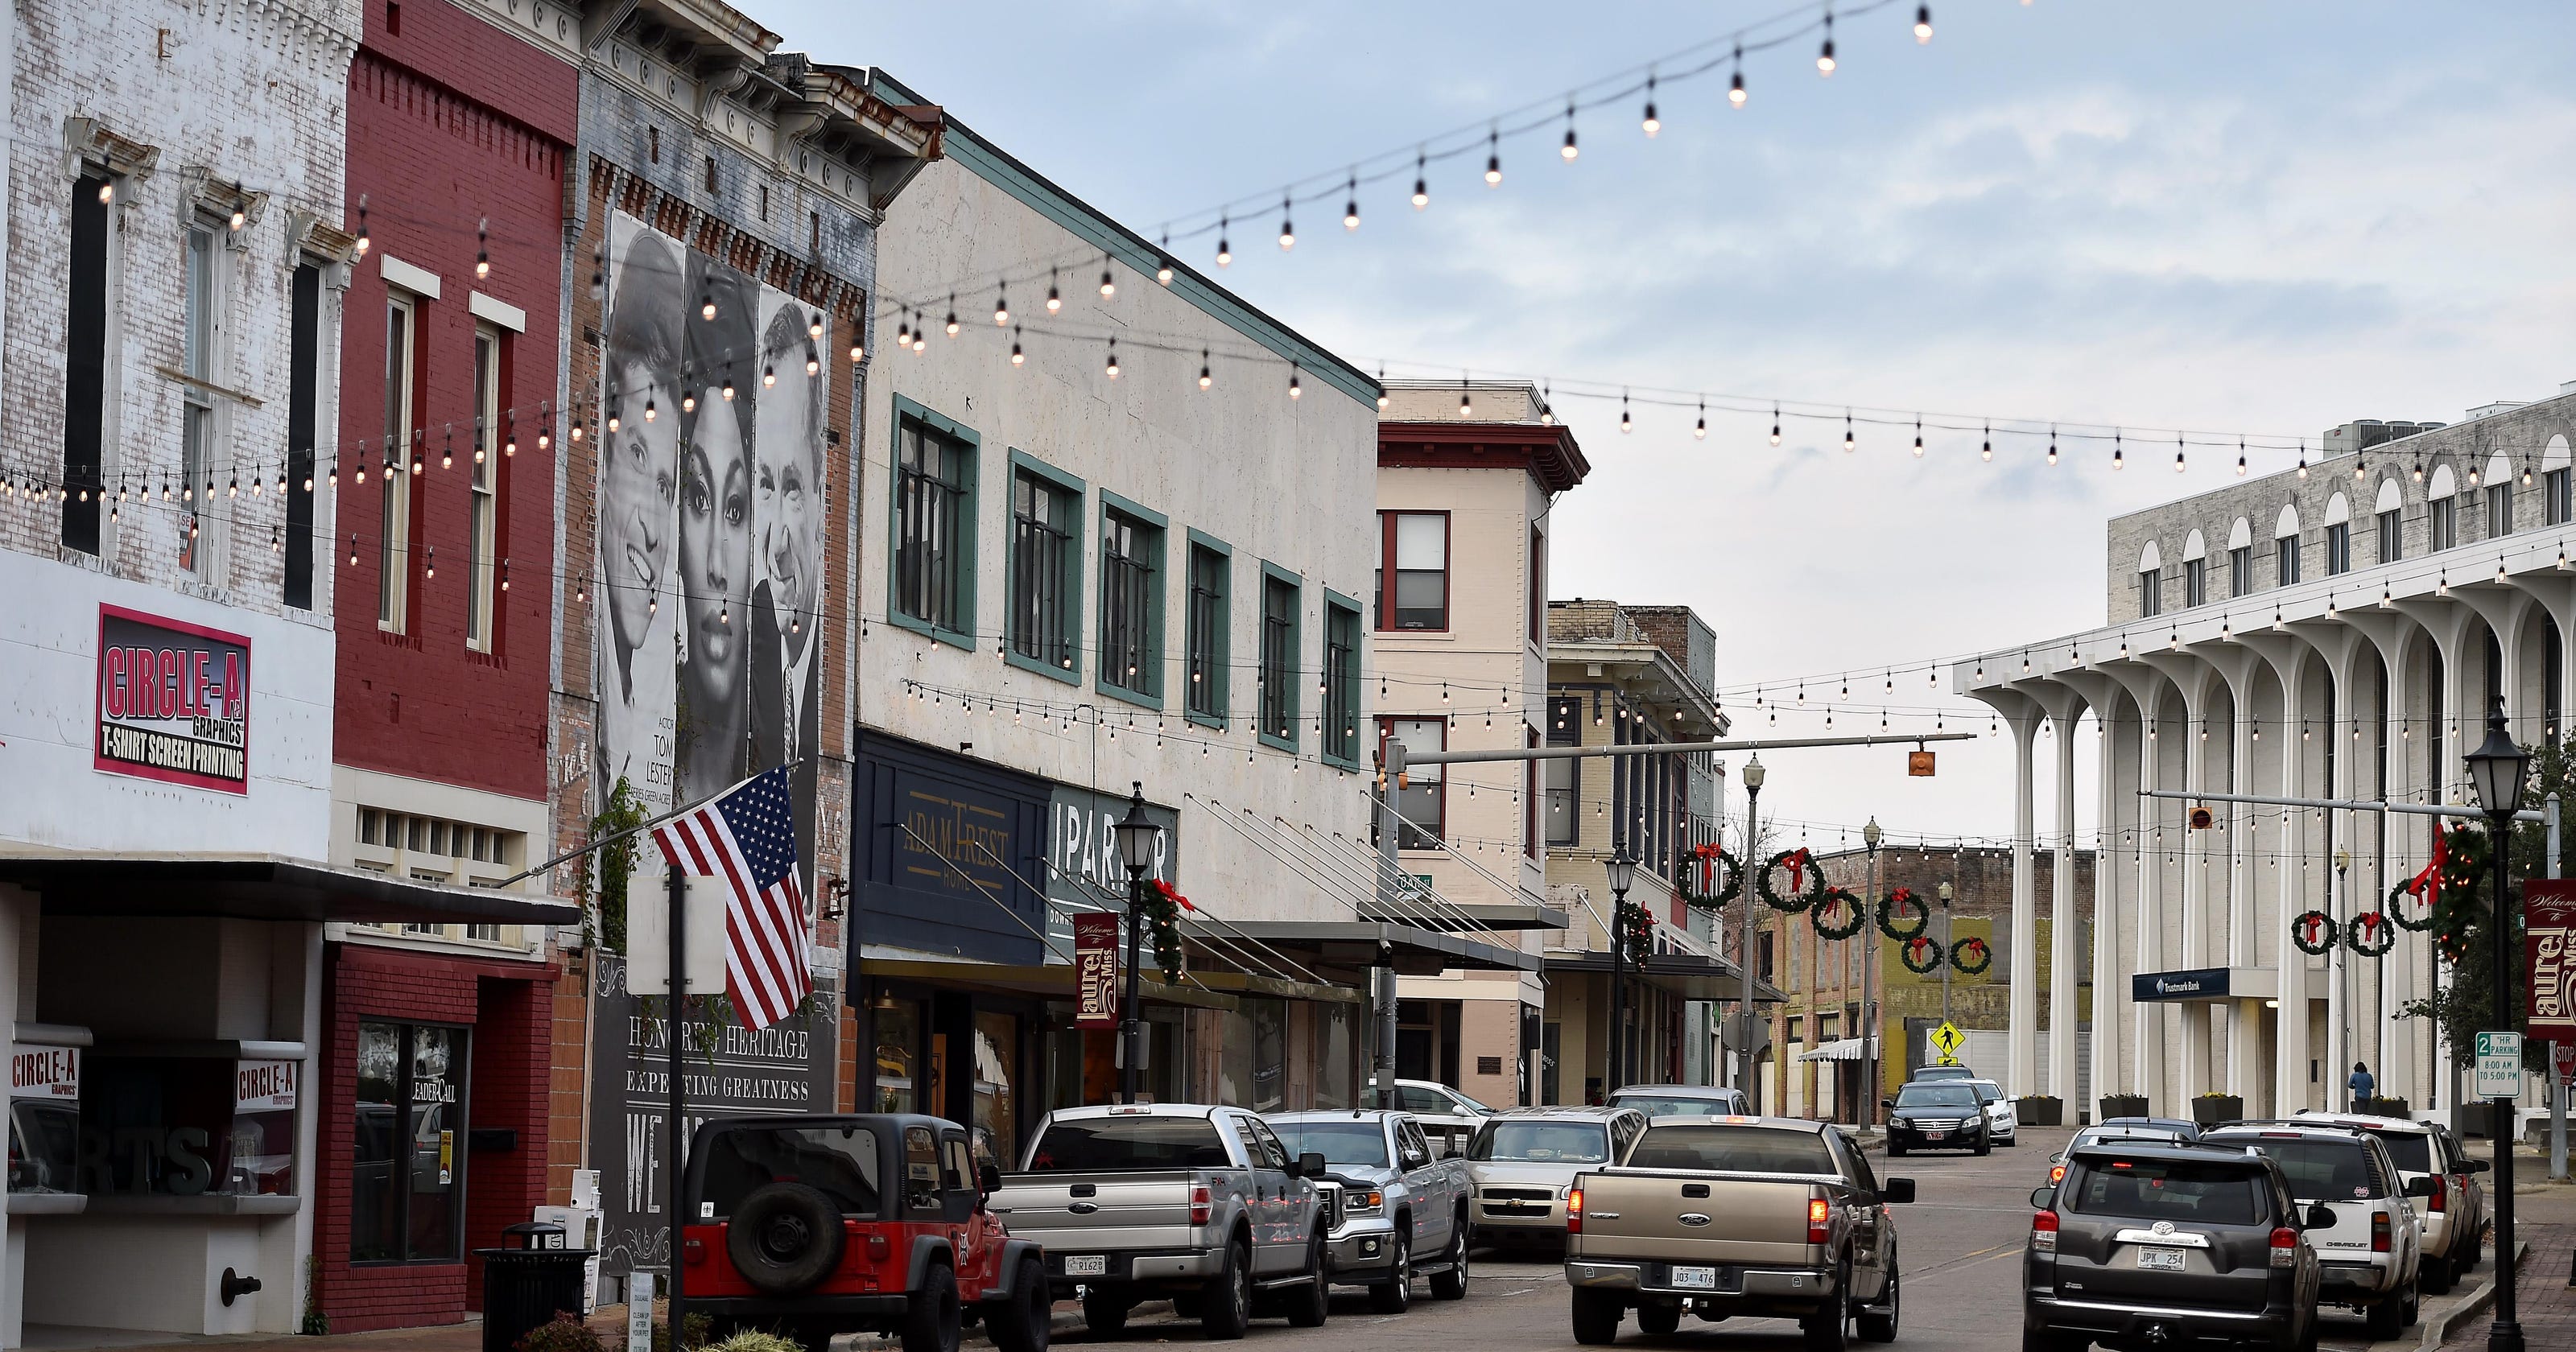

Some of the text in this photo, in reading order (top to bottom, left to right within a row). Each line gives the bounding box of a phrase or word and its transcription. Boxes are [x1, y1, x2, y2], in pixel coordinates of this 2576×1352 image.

[105, 645, 242, 720] CIRCLE-A
[192, 715, 242, 745] GRAPHICS
[658, 717, 673, 729] ACTOR
[102, 725, 243, 779] T-SHIRT SCREEN PRINTING
[654, 735, 673, 758] TOM
[646, 760, 672, 786] LESTER
[645, 789, 658, 802] GREEN
[658, 793, 671, 805] ACRES
[1051, 803, 1166, 892] JPARR
[1077, 924, 1116, 936] Welcome
[2165, 981, 2199, 992] Trustmark Bank
[725, 1025, 808, 1059] HERITAGE
[2479, 1037, 2510, 1053] 2 HR
[2491, 1046, 2517, 1054] PARKING
[2556, 1046, 2575, 1062] STOP
[12, 1049, 76, 1087] CIRCLE-A
[2508, 1072, 2517, 1080] PM
[52, 1083, 76, 1096] GRAPHICS
[239, 1063, 293, 1101] CIRCLE-A
[625, 1070, 808, 1101] EXPETING GREATNESS
[626, 1114, 663, 1213] WE
[1212, 1177, 1226, 1186] FX4
[1079, 1262, 1097, 1271] R162
[2140, 1253, 2183, 1264] JPK 254
[1699, 1274, 1713, 1284] 476
